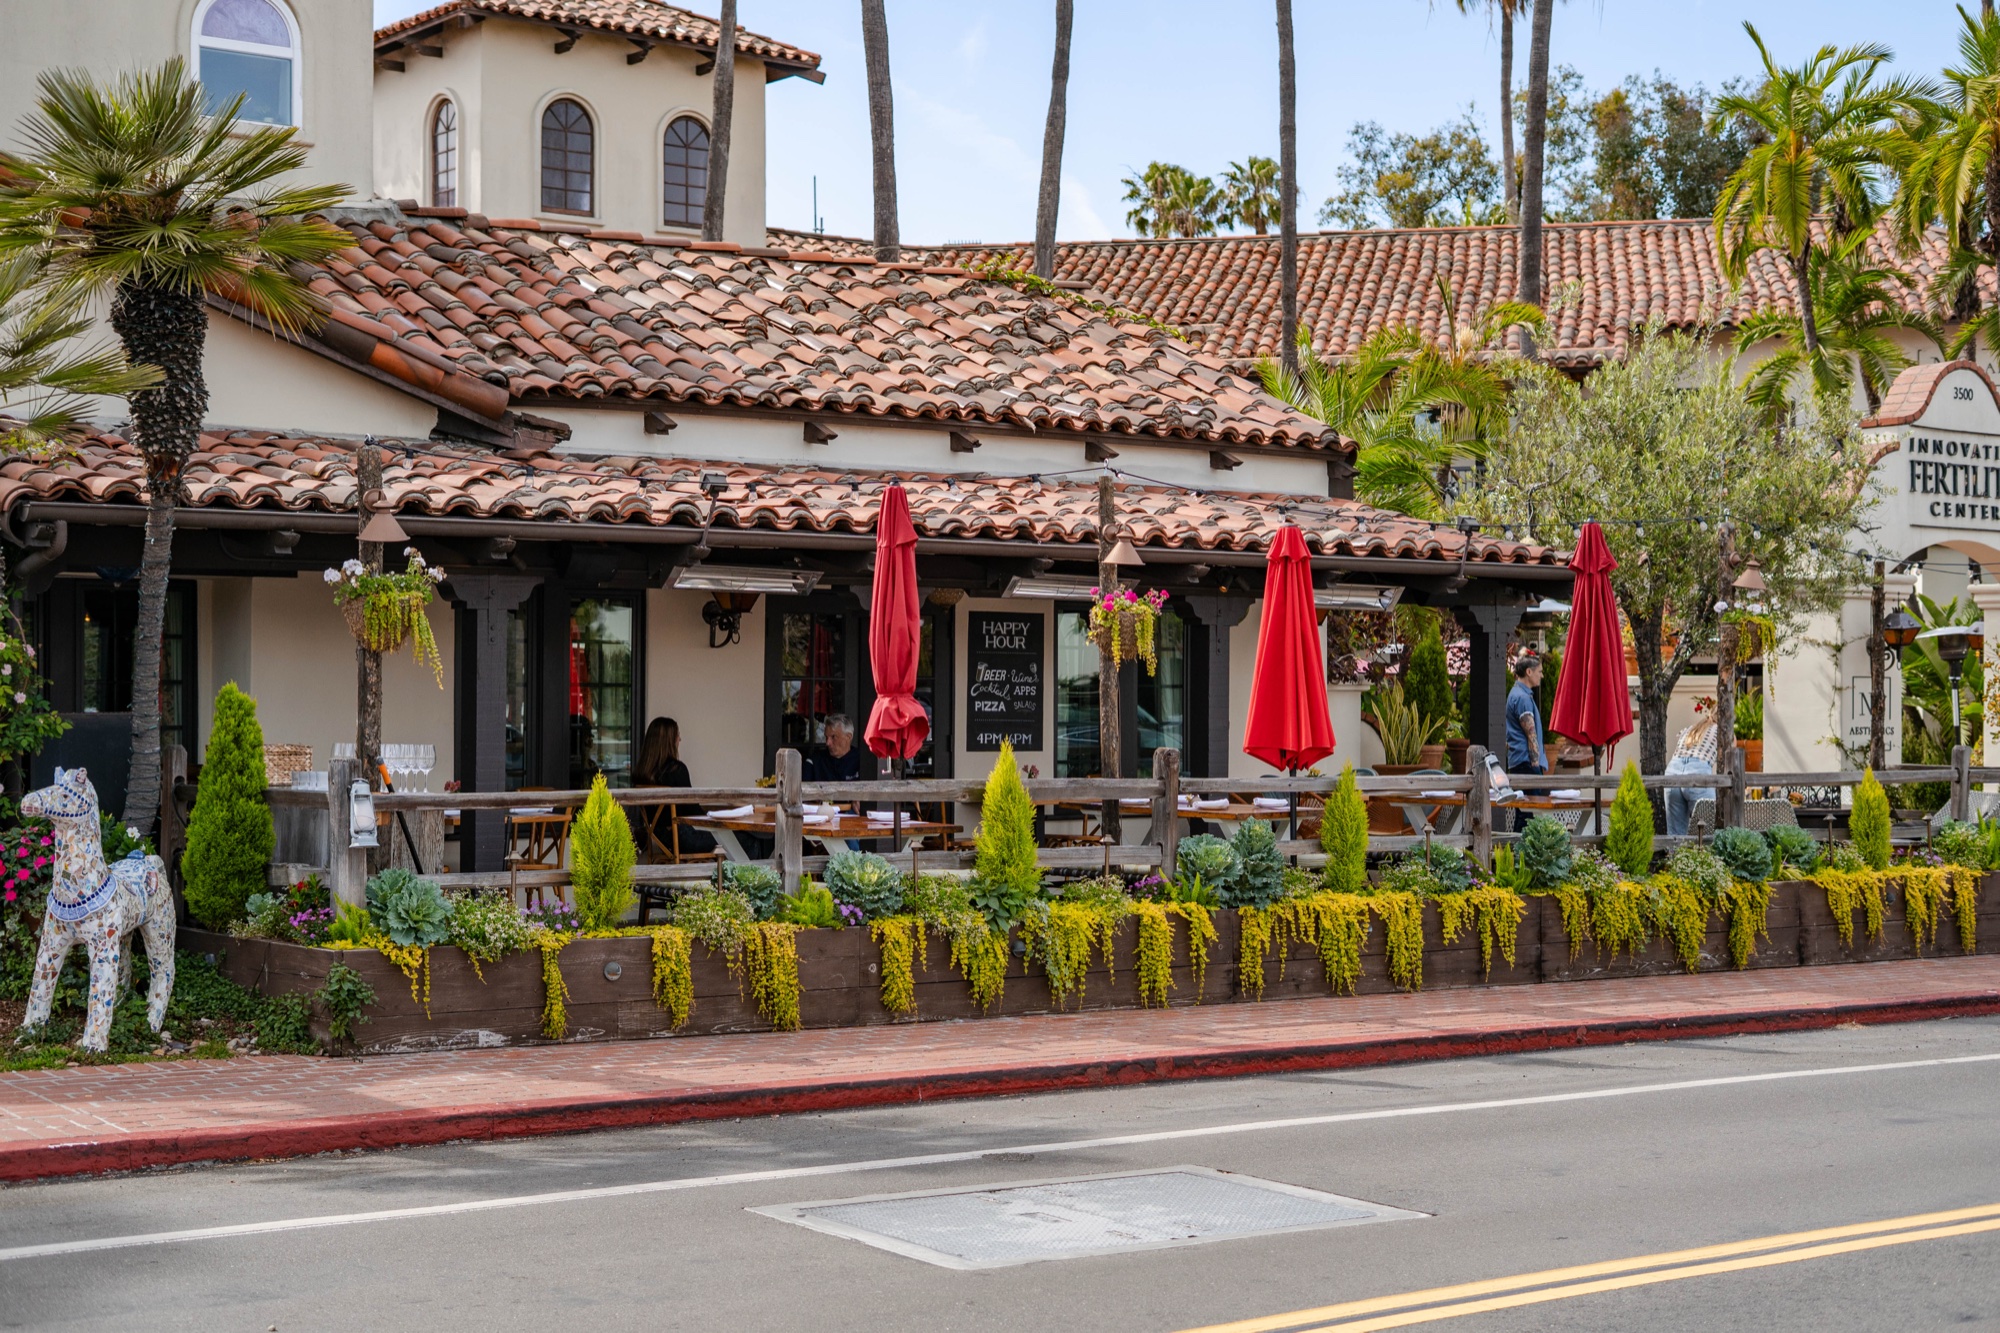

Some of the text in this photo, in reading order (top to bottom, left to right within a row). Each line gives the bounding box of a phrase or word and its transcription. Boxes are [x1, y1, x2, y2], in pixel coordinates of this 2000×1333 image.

[1953, 386, 1974, 401] 3500
[1909, 437, 2000, 461] INNOVATI
[1930, 501, 2000, 521] CENTER
[982, 621, 1031, 636] HAPPY
[985, 635, 1026, 649] HOUR
[983, 669, 1007, 682] BEER
[1013, 685, 1037, 696] APPS
[974, 701, 1007, 712] PIZZA
